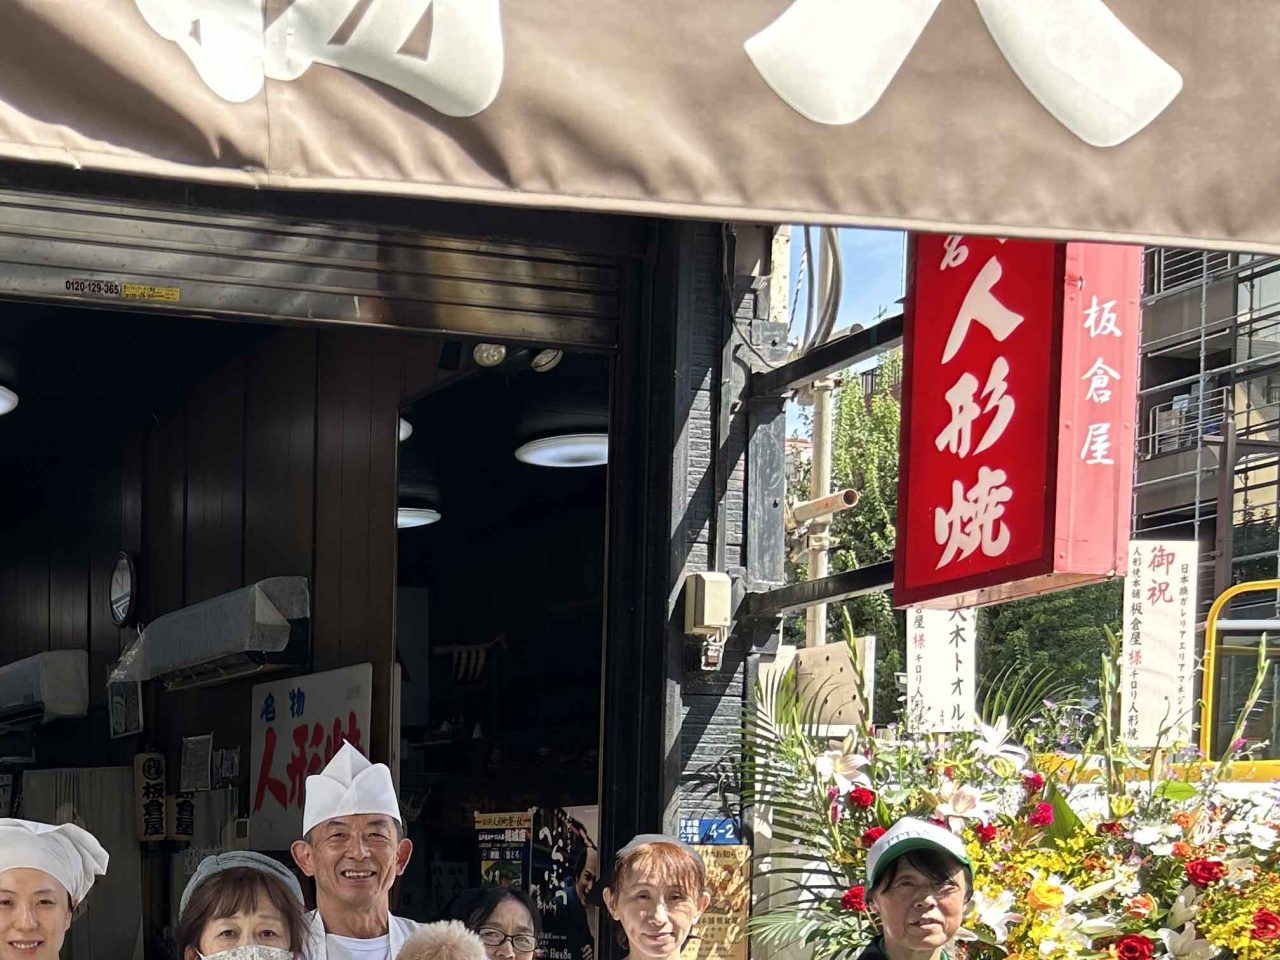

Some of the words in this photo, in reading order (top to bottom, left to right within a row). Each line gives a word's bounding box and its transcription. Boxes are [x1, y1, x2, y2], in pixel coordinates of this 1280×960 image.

[65, 281, 119, 294] 0120-129-365
[1080, 294, 1122, 465] 板倉屋
[935, 255, 1024, 570] 人形焼
[1147, 545, 1176, 606] 御祝
[1130, 602, 1143, 646] 板倉屋
[1128, 649, 1142, 666] 様
[260, 687, 306, 723] 名物
[1127, 669, 1139, 741] チロリ人形焼
[709, 824, 735, 838] 4-2
